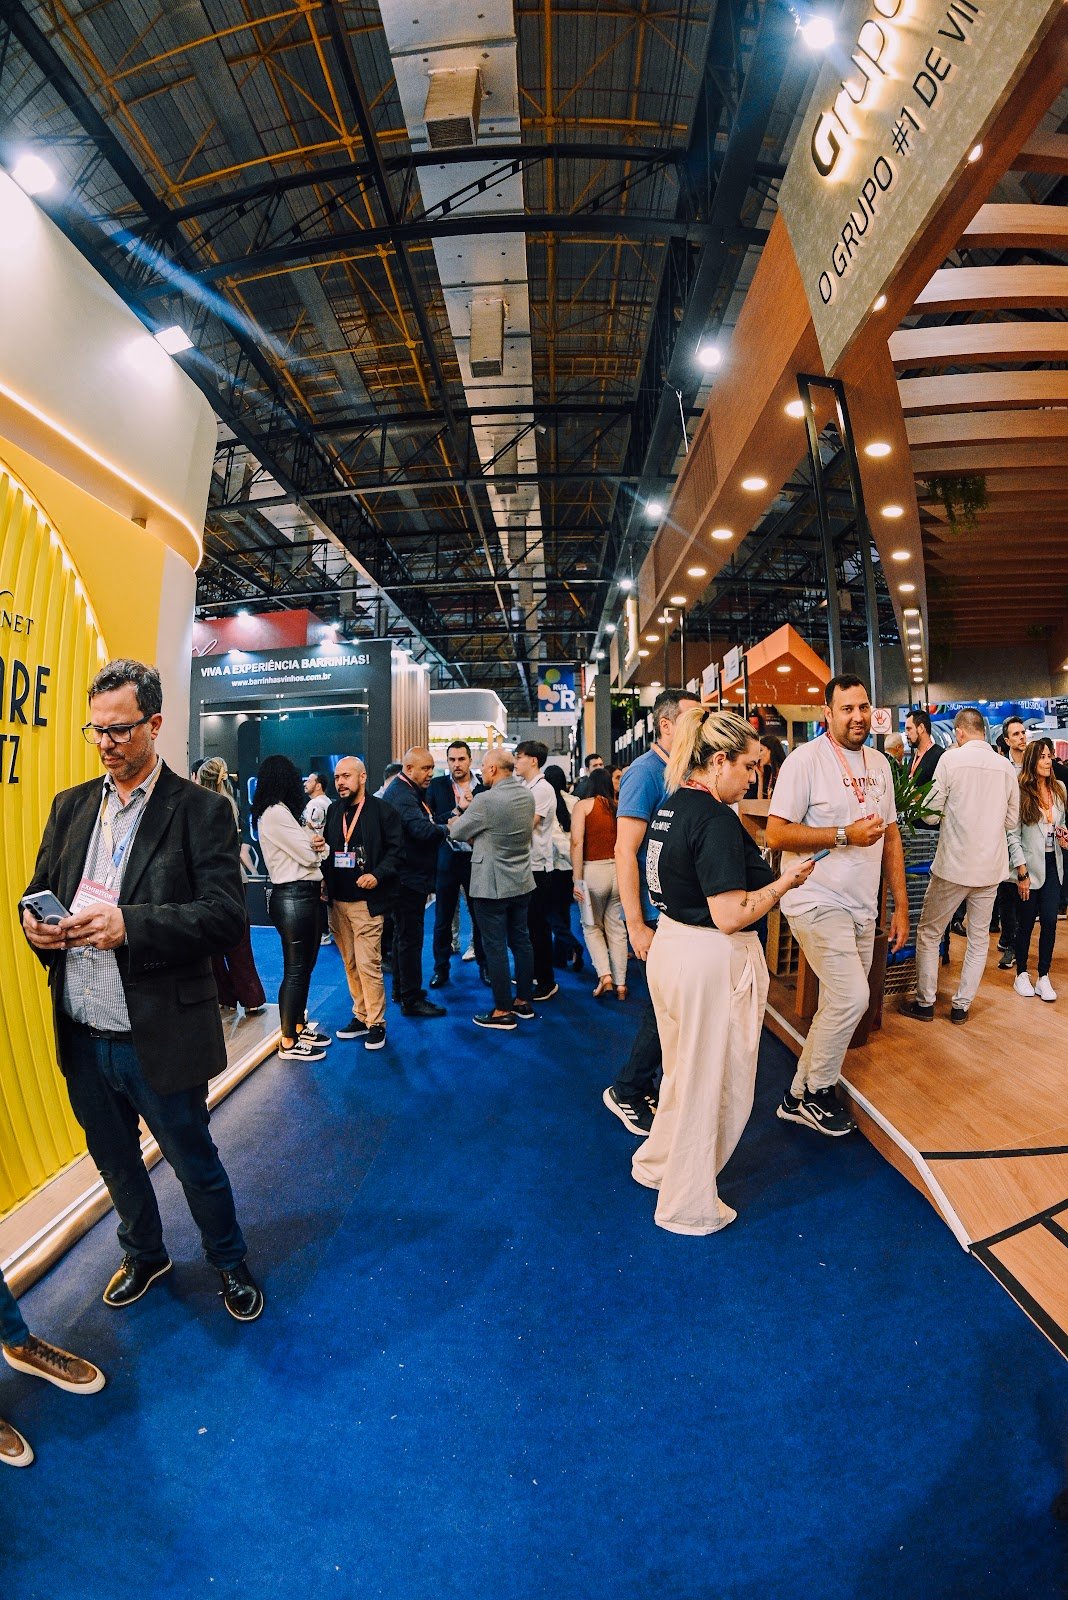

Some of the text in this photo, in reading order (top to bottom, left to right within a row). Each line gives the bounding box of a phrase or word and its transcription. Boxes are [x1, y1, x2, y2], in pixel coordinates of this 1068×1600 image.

[818, 271, 834, 305] O
[832, 155, 896, 278] GRUPO
[891, 105, 922, 157] #1
[912, 47, 953, 108] DE
[0, 609, 35, 635] NET
[201, 654, 370, 678] VIVA A EXPERIÊNCIA BARRINHAS!
[231, 673, 331, 687] www.barrinhasvinhos.com.br
[552, 683, 568, 691] RUA
[560, 690, 576, 710] R
[81, 882, 114, 900] EXHIBITOR
